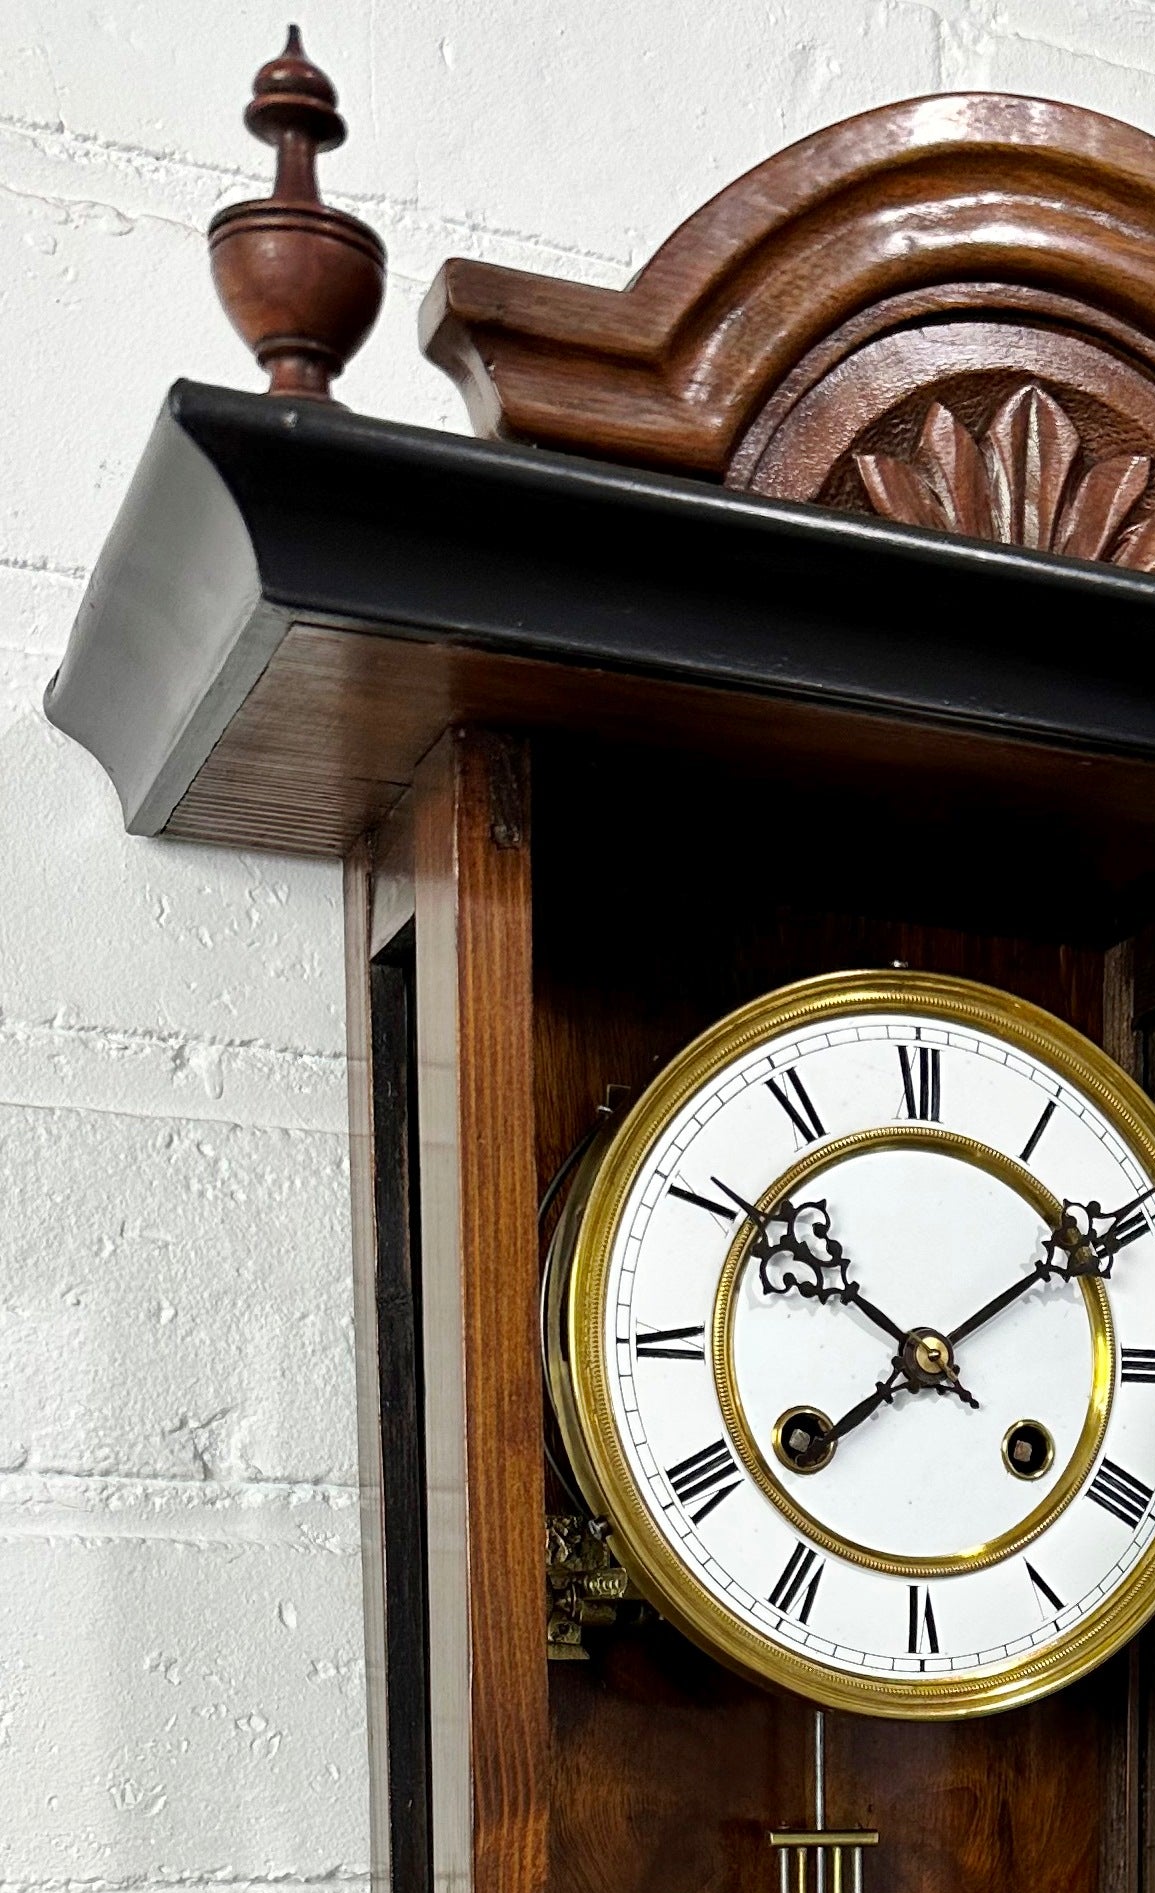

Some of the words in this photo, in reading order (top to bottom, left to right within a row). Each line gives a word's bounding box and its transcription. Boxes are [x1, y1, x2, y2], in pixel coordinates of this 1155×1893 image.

[762, 1065, 831, 1153] XI
[892, 1044, 944, 1124] XII
[1015, 1097, 1060, 1166] I
[665, 1170, 741, 1238] X
[636, 1317, 706, 1365] IX
[664, 1432, 745, 1529] VIII
[1082, 1453, 1155, 1533] IIII
[764, 1537, 826, 1627] VII
[904, 1584, 940, 1654] VI
[1023, 1556, 1069, 1621] V
